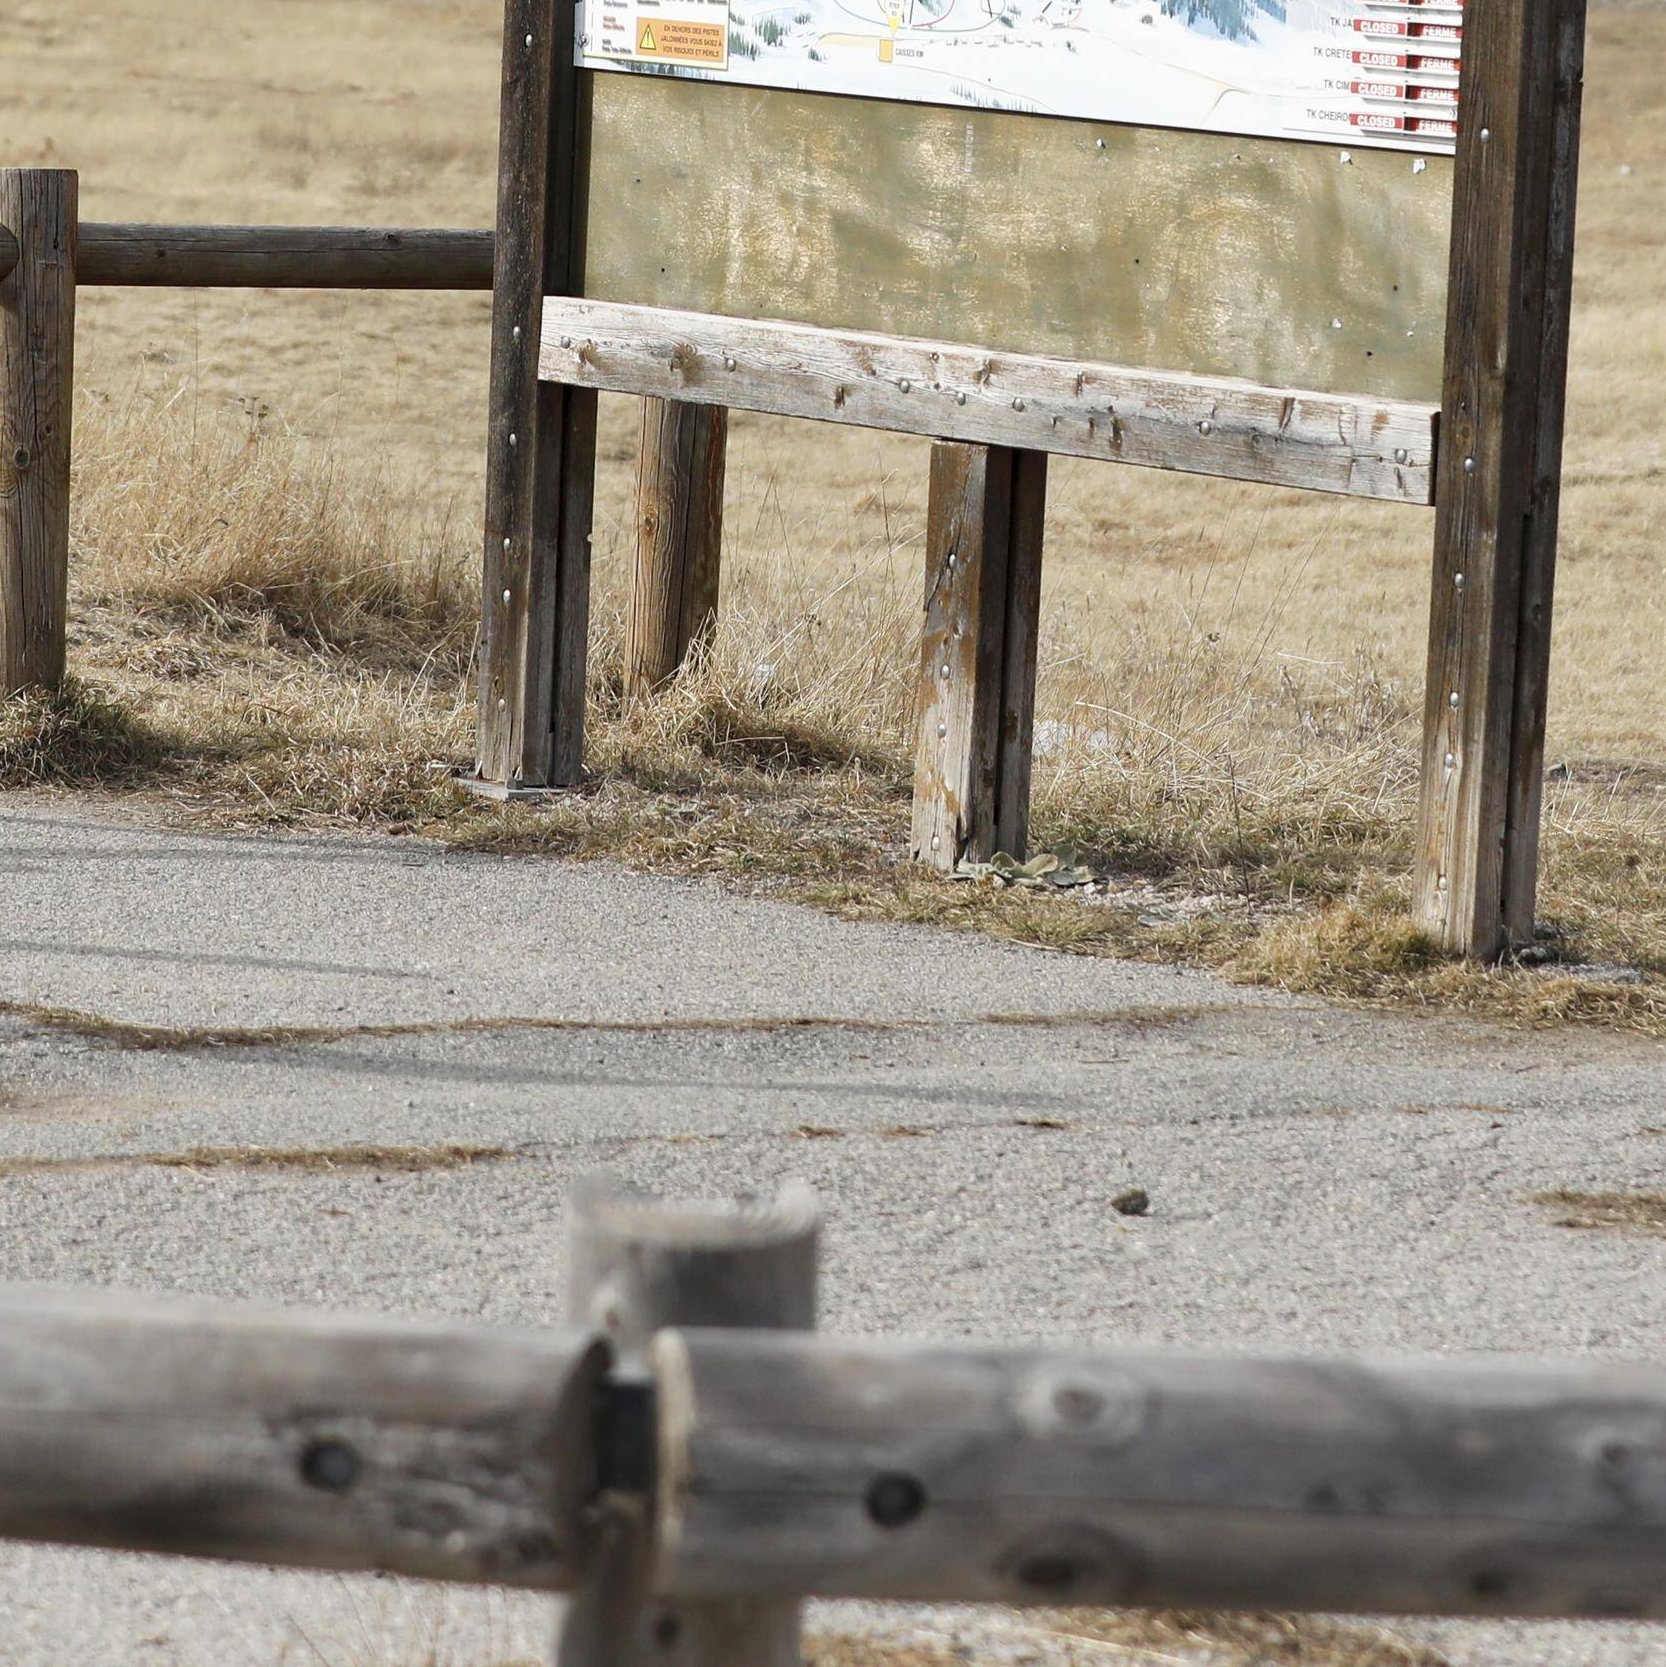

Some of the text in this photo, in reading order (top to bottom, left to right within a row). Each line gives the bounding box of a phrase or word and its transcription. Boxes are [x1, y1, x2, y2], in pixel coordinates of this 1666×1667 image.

[1330, 16, 1353, 27] TK JA
[1360, 19, 1457, 38] CLOSED FERME
[1313, 46, 1323, 57] TK
[1359, 53, 1455, 70] CLOSED FERME
[1324, 79, 1350, 90] TK CIM
[1358, 83, 1454, 100] CLOSED FERME
[1306, 109, 1349, 121] TK CHEIRO
[1357, 114, 1453, 132] CLOSED FERME
